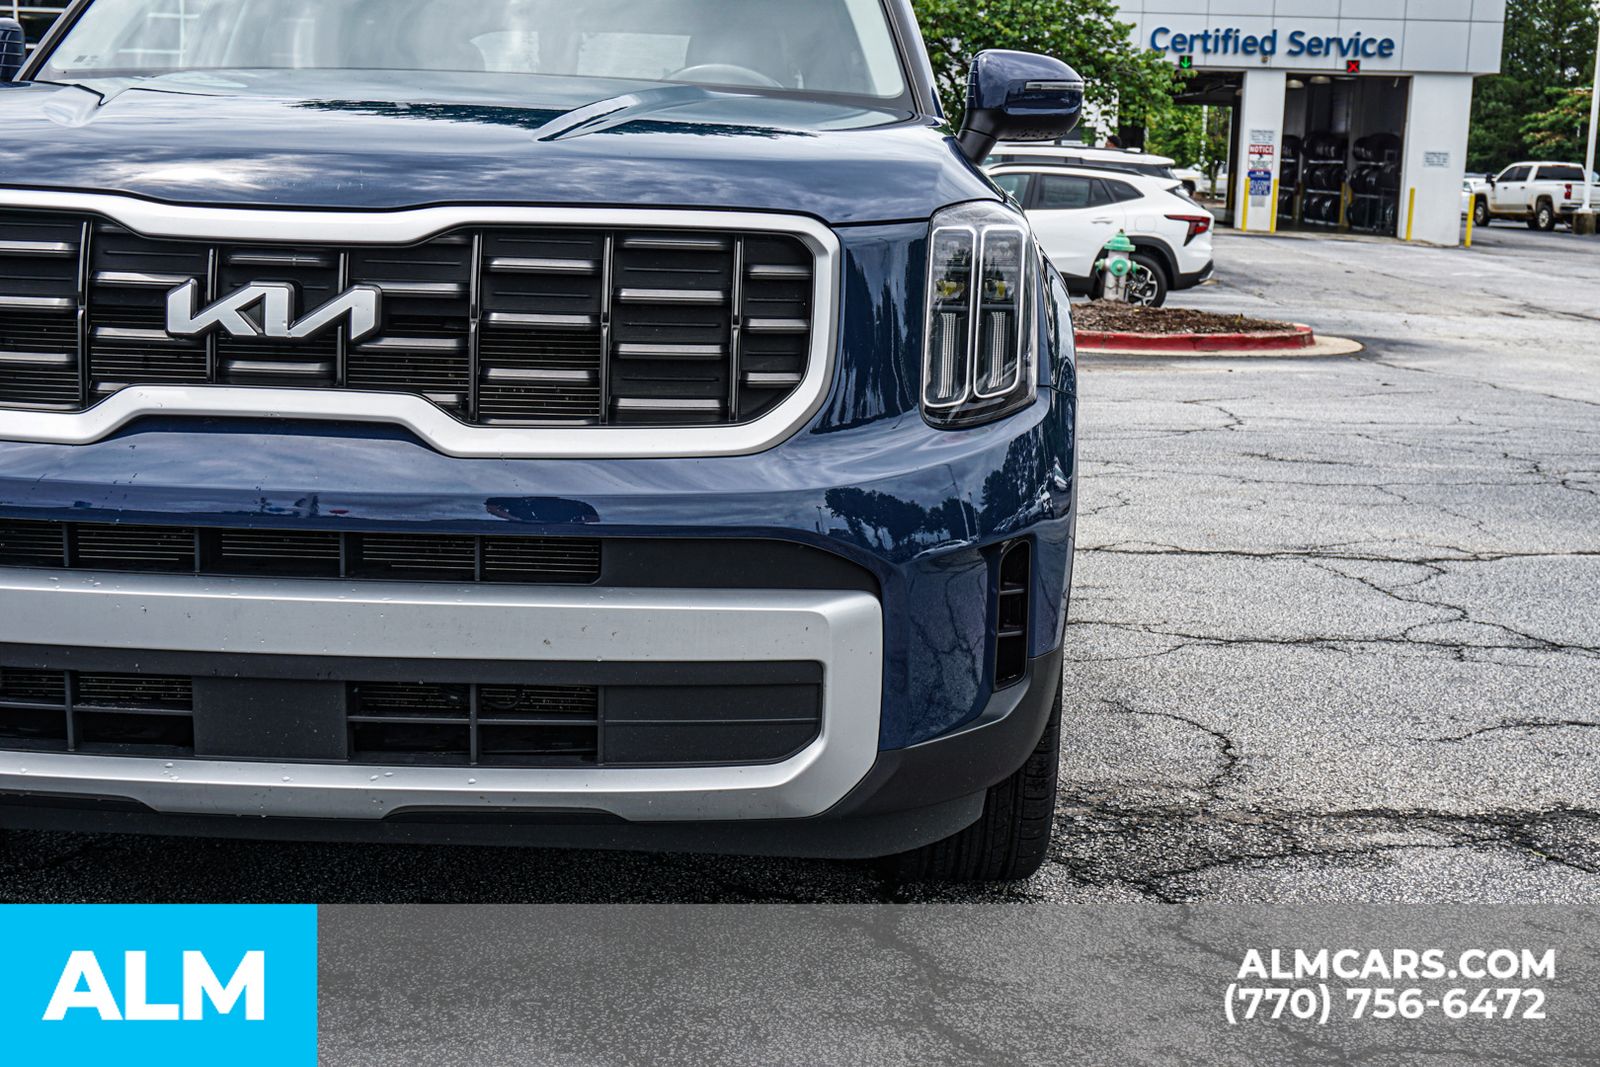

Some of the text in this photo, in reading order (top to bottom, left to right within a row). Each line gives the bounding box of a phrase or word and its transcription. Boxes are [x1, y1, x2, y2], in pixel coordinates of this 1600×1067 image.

[1150, 27, 1396, 58] Certified Service
[1249, 145, 1273, 154] NOTICE
